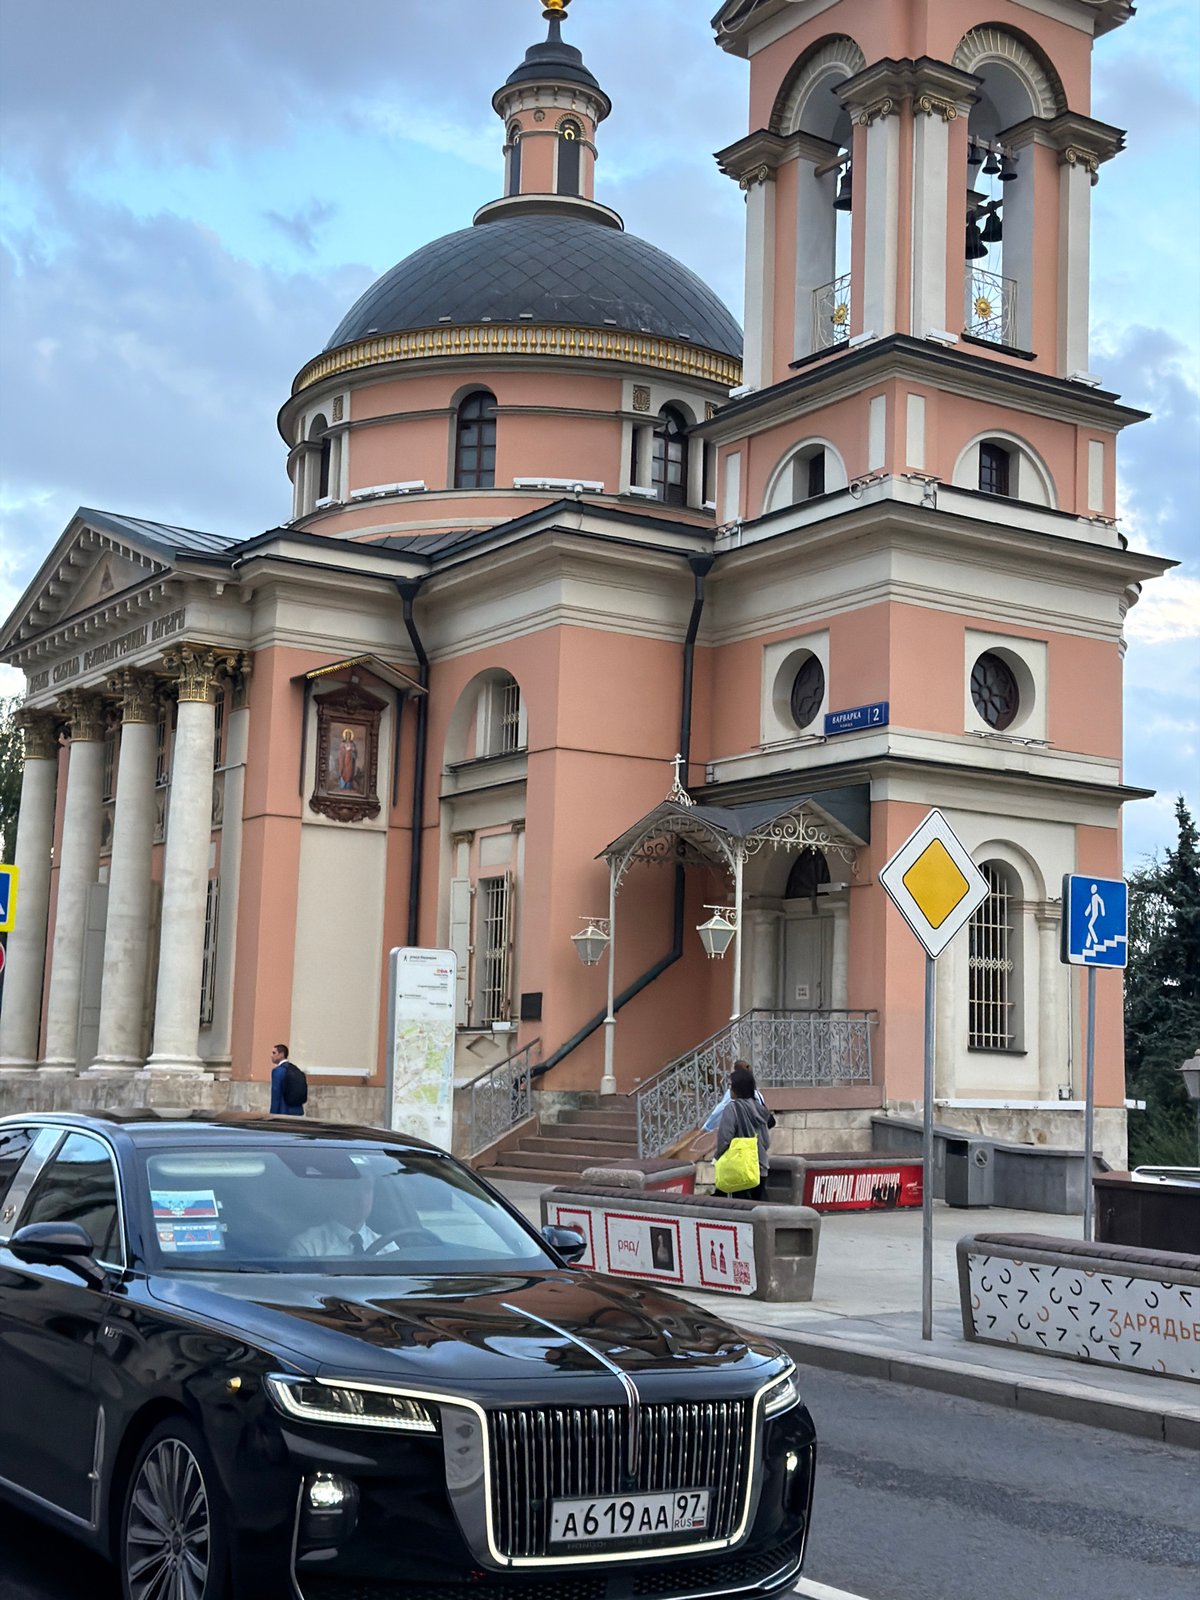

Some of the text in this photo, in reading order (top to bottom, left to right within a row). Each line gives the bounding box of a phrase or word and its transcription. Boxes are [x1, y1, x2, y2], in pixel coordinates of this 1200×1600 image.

[832, 708, 880, 724] ВАРВАРКА 2
[677, 1494, 701, 1518] 97
[674, 1517, 692, 1529] RUS
